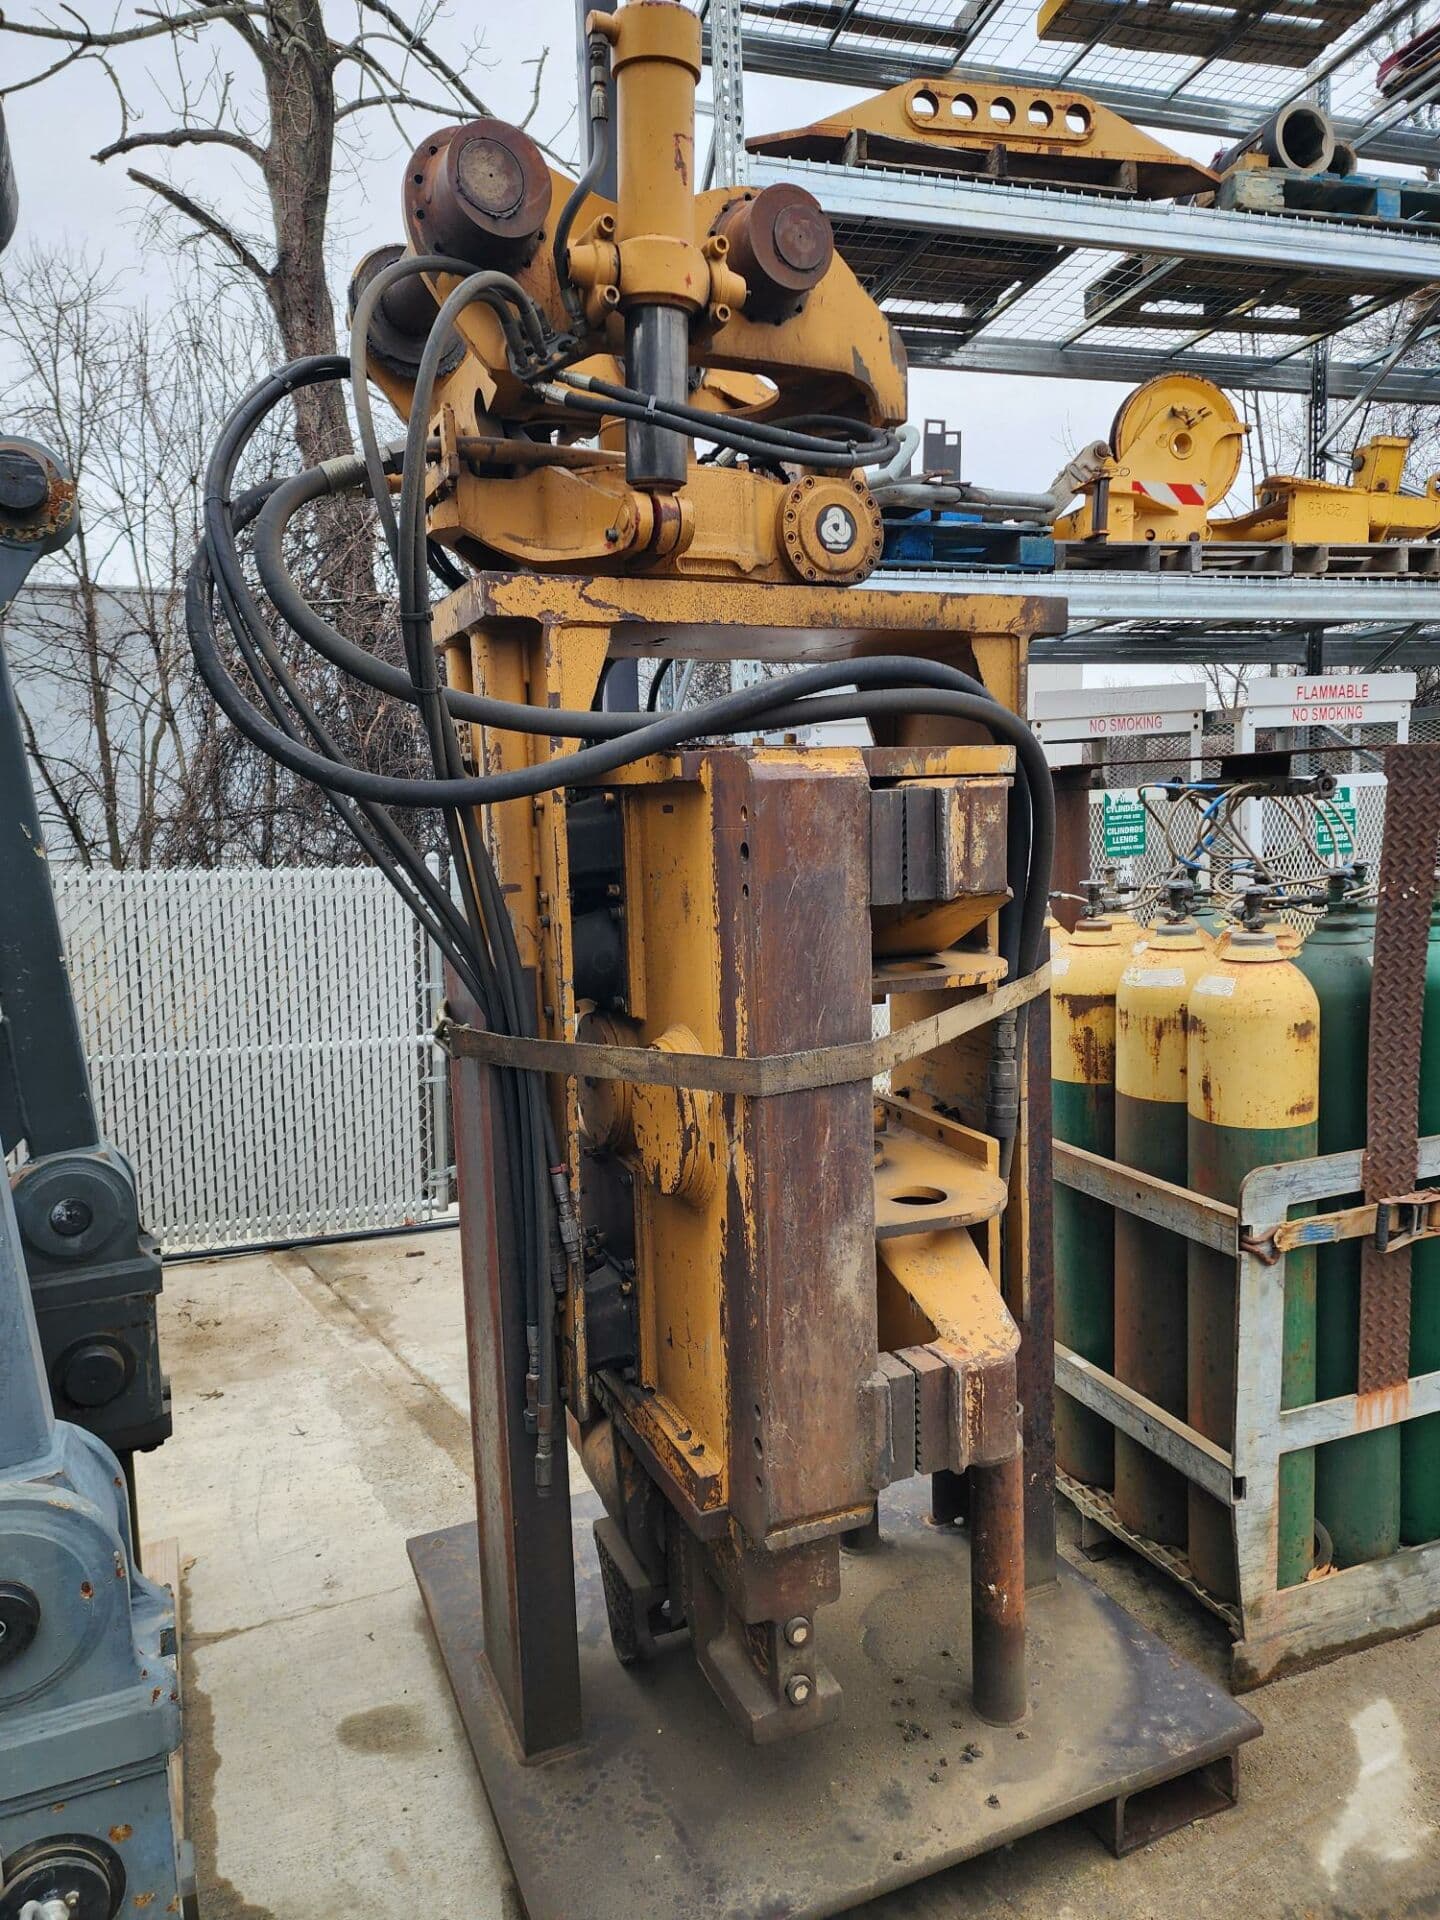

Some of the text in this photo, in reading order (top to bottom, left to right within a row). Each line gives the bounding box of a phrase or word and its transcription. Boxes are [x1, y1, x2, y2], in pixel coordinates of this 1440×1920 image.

[1296, 684, 1369, 700] FLAMMABLE
[1292, 705, 1363, 722] NO SMOKING
[1089, 715, 1163, 733] NO SMOKING
[1105, 803, 1144, 814] CYLINDERS
[1106, 825, 1144, 835] CILINDROS
[1112, 835, 1139, 844] LLENOS
